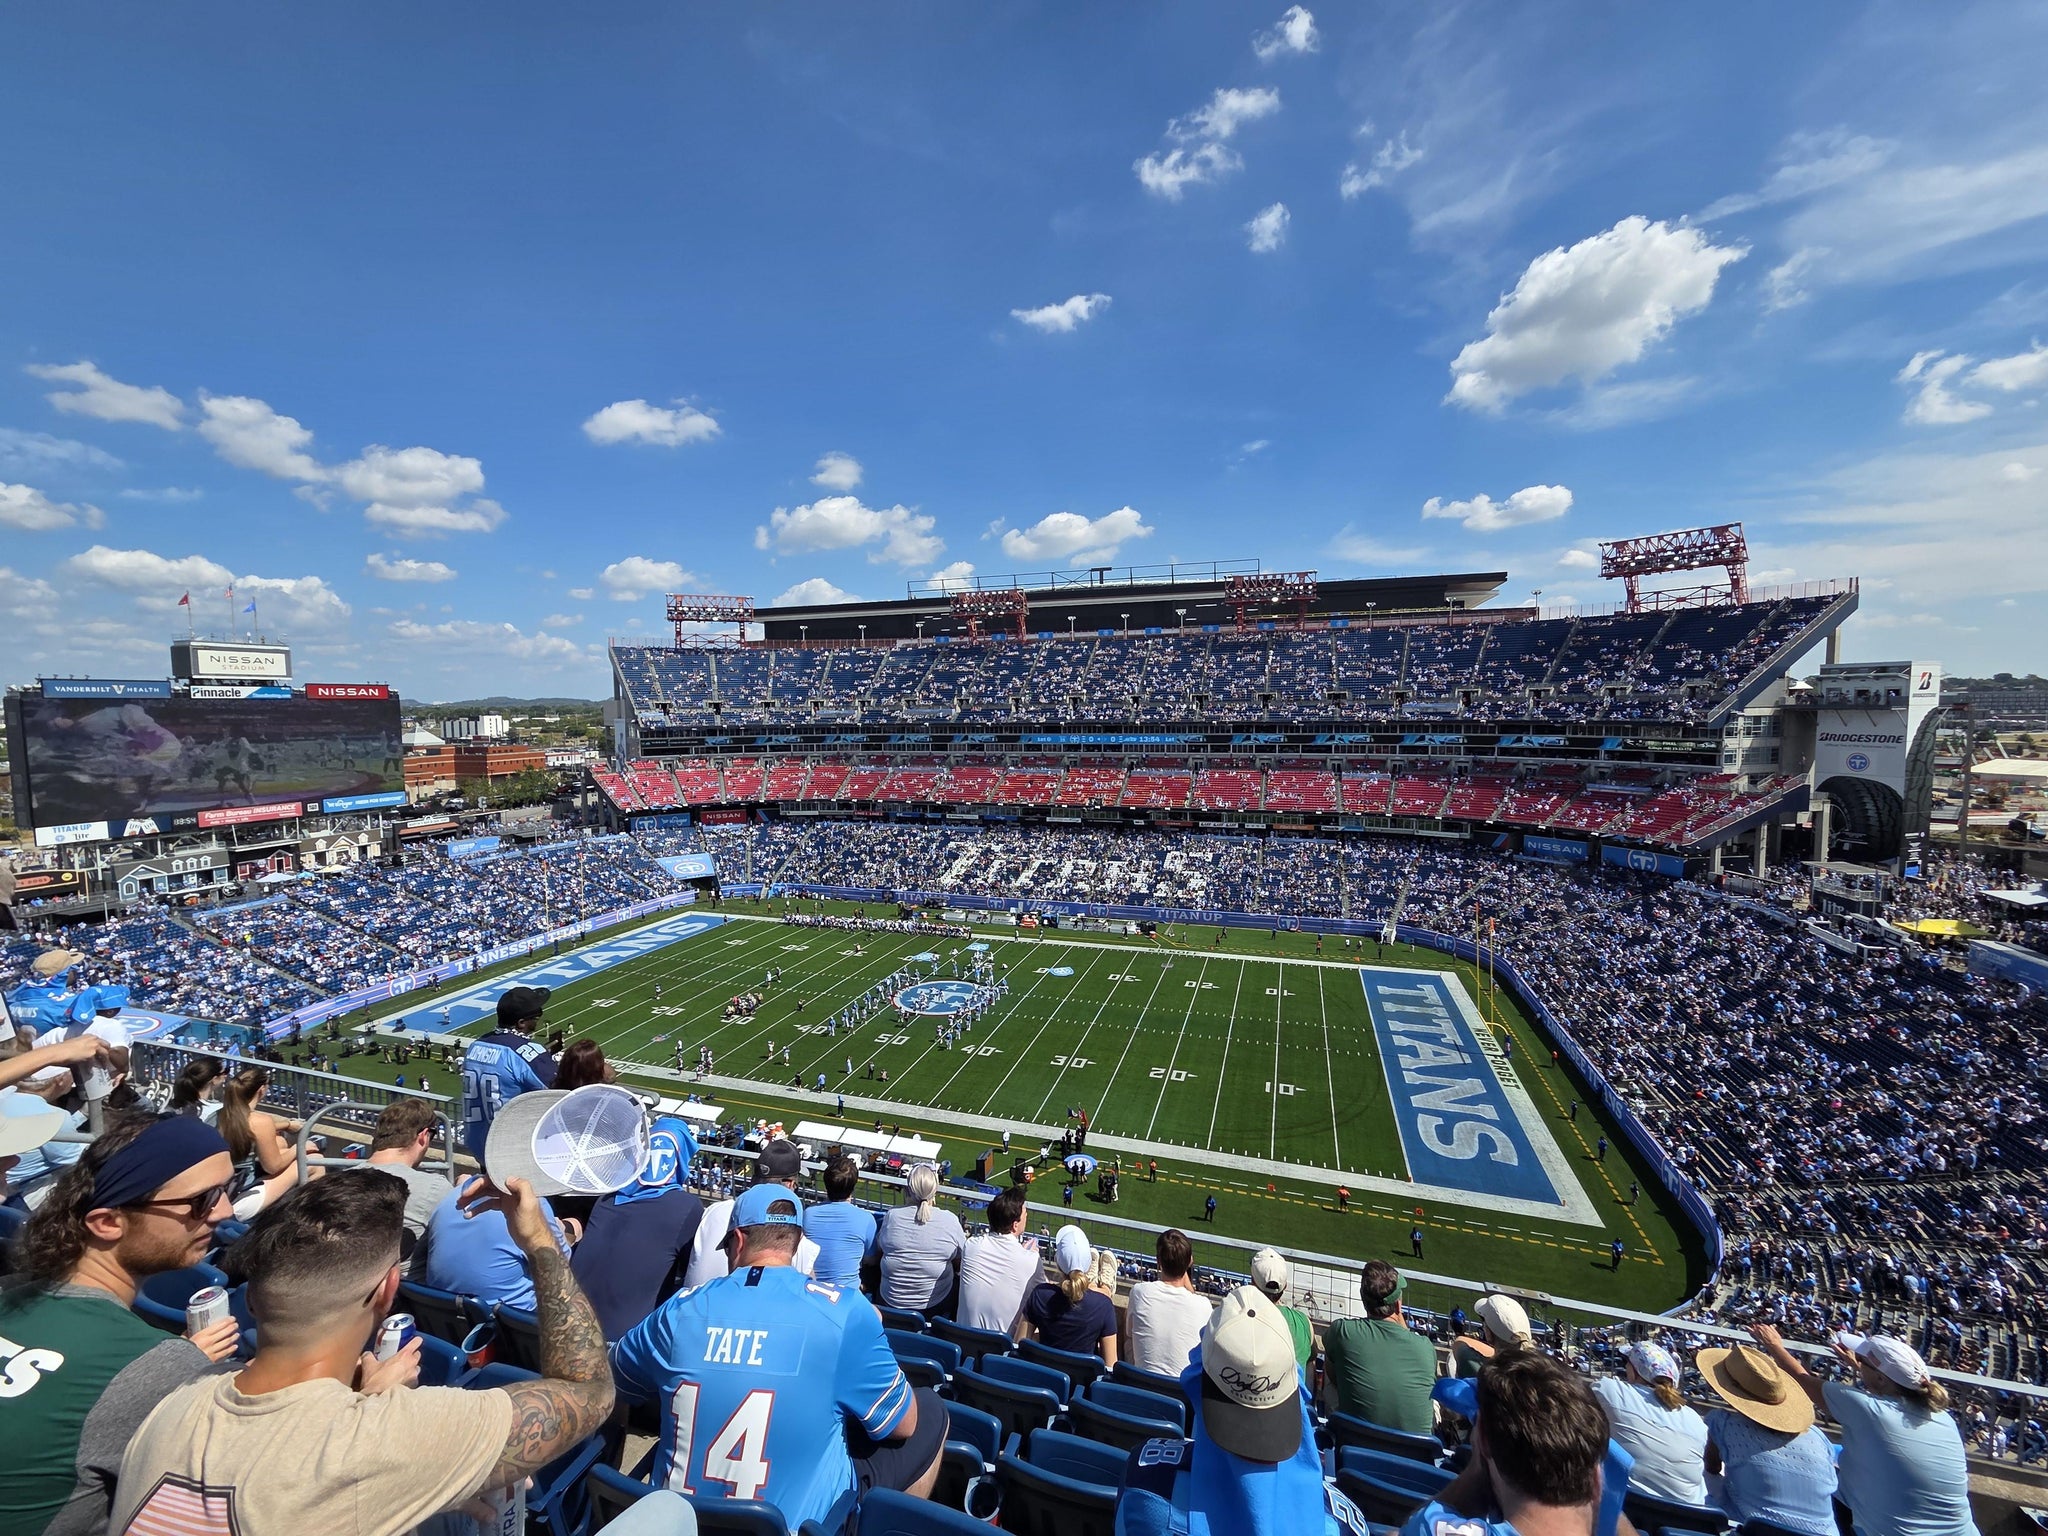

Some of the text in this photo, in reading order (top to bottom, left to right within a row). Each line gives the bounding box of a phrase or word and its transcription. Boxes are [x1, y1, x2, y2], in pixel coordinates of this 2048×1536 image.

[209, 655, 275, 665] NISSAN
[191, 687, 241, 698] Pinnacle
[318, 687, 379, 697] NISSAN
[1818, 732, 1904, 744] BRIDGESTONE
[253, 804, 297, 814] INSURANCE
[52, 823, 92, 833] TITAN UP
[1527, 841, 1582, 855] NISSAN
[1155, 909, 1224, 922] TITAN UP
[455, 937, 546, 973] TENNESSEE
[547, 920, 595, 945] TITANS
[651, 1006, 686, 1016] 20
[797, 1024, 828, 1035] 40
[873, 1033, 911, 1045] 50
[467, 1045, 501, 1065] JOHNSON
[960, 1044, 996, 1057] 40
[1050, 1054, 1089, 1069] 30
[1473, 1027, 1521, 1091] NEVER FORGET
[1148, 1066, 1188, 1082] 20
[1376, 984, 1520, 1167] TITANS
[1264, 1081, 1295, 1096] 10
[704, 1325, 769, 1366] TATE
[1230, 1389, 1276, 1402] COLLECTIVE
[667, 1380, 776, 1500] 14
